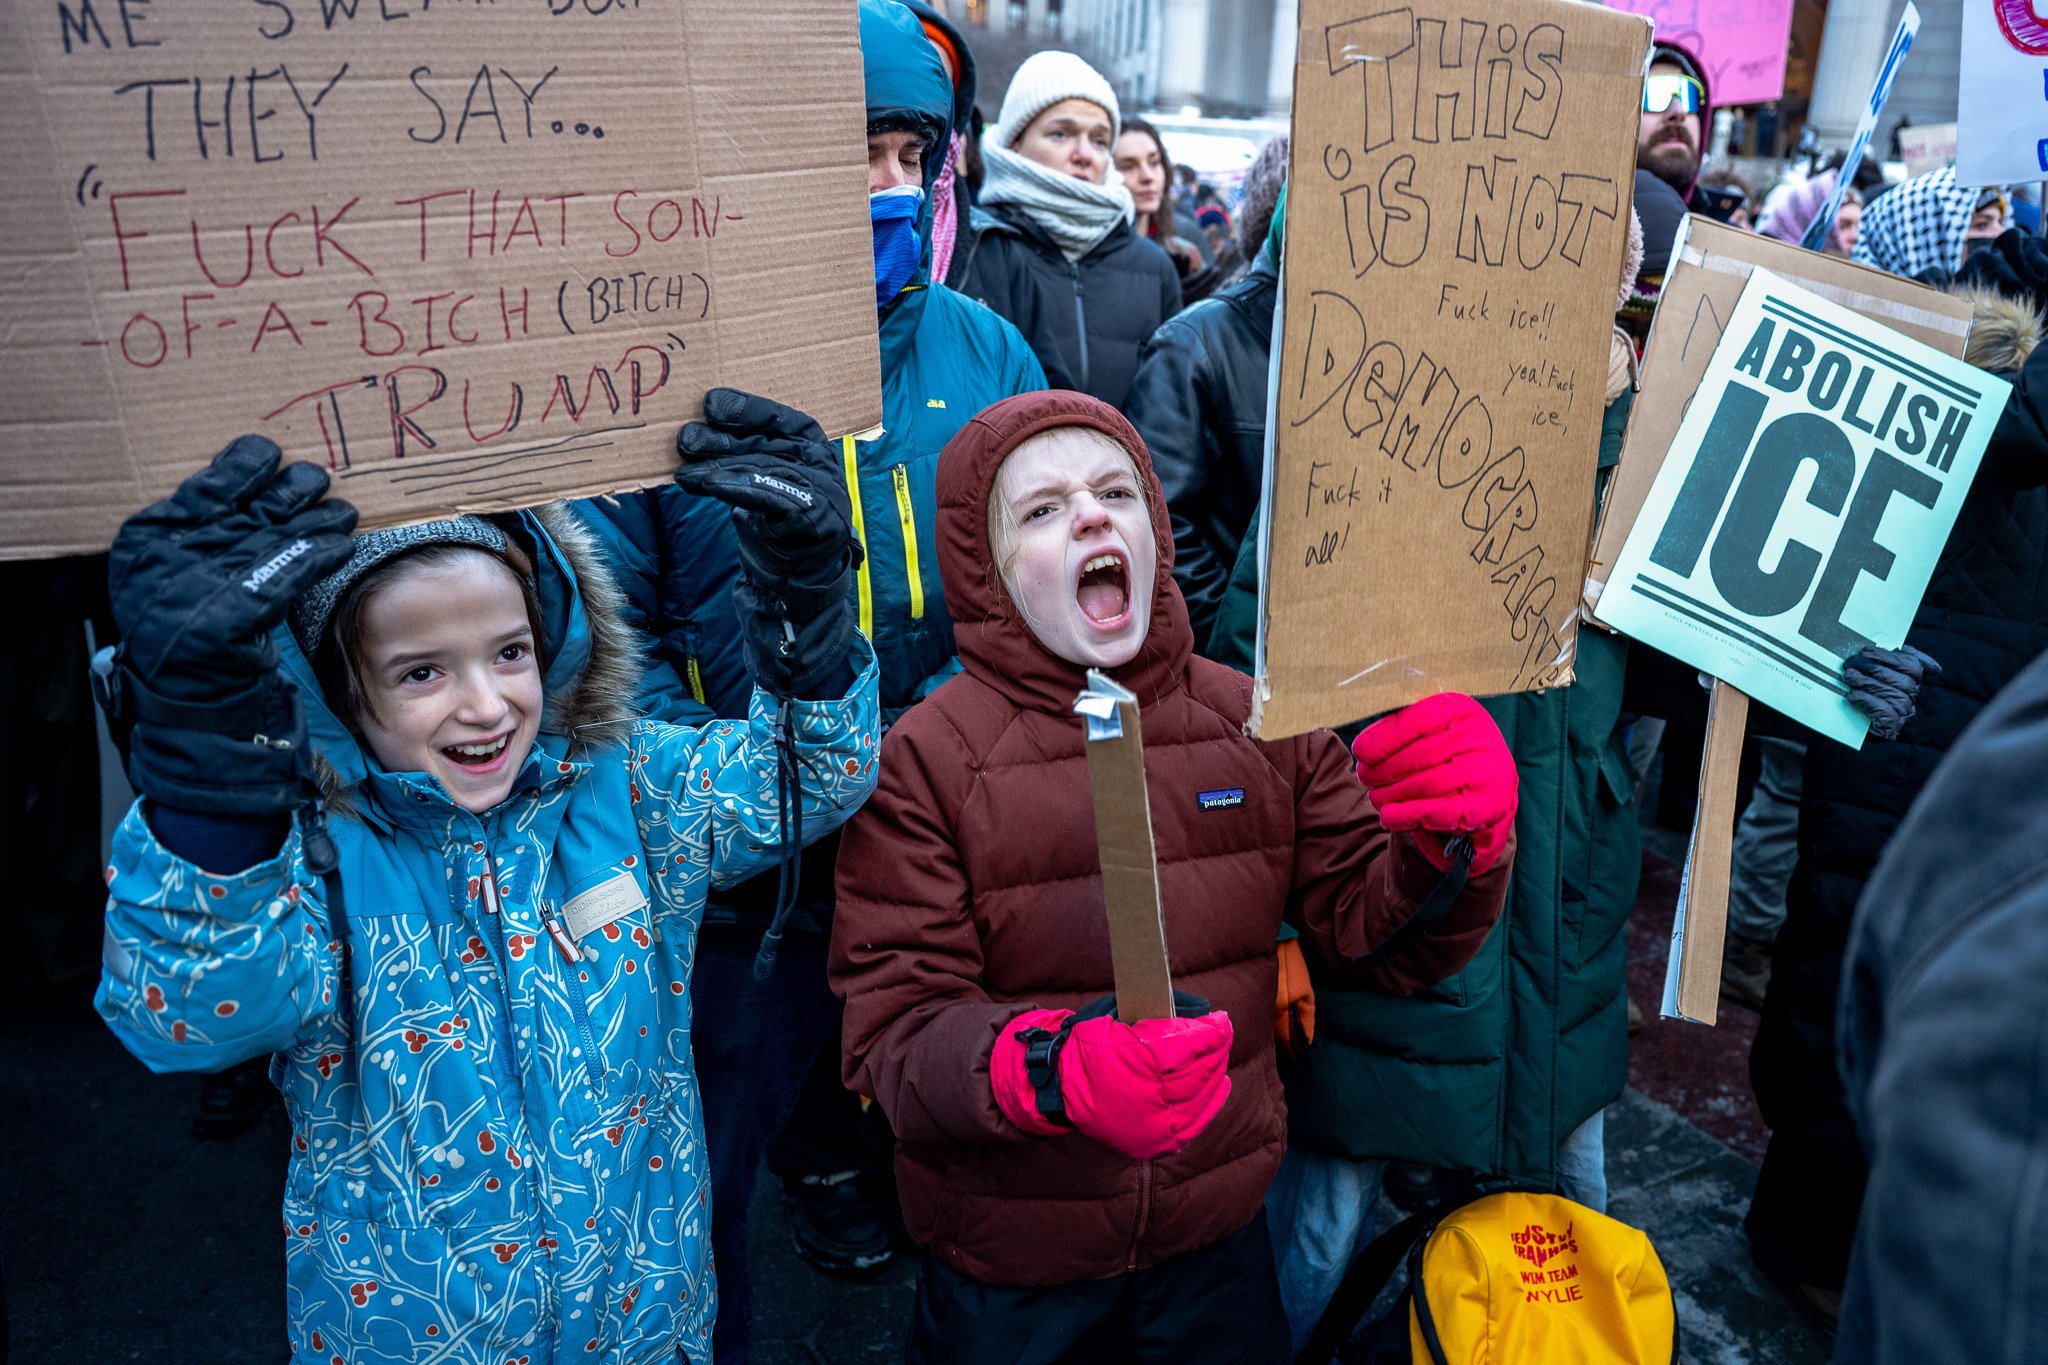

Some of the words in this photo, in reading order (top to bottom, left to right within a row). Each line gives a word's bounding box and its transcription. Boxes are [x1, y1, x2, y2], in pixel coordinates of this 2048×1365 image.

[57, 0, 162, 53] ME
[115, 63, 349, 163] THEY
[408, 63, 605, 144] SAY...
[395, 188, 586, 262] THAT
[605, 188, 744, 258] SON-
[1456, 155, 1619, 271] NOT
[556, 271, 710, 336] (BITCH)
[1437, 283, 1489, 321] Fuck
[1734, 317, 1973, 474] ABOLISH
[753, 473, 813, 506] Marmot
[1305, 461, 1360, 518] Fuck
[1378, 476, 1393, 504] it
[1649, 379, 1944, 668] ICE
[241, 539, 314, 593] Marmot
[1204, 797, 1241, 808] patagonia
[571, 882, 626, 915] DIDRIKSONS
[1547, 1264, 1579, 1283] TEAM
